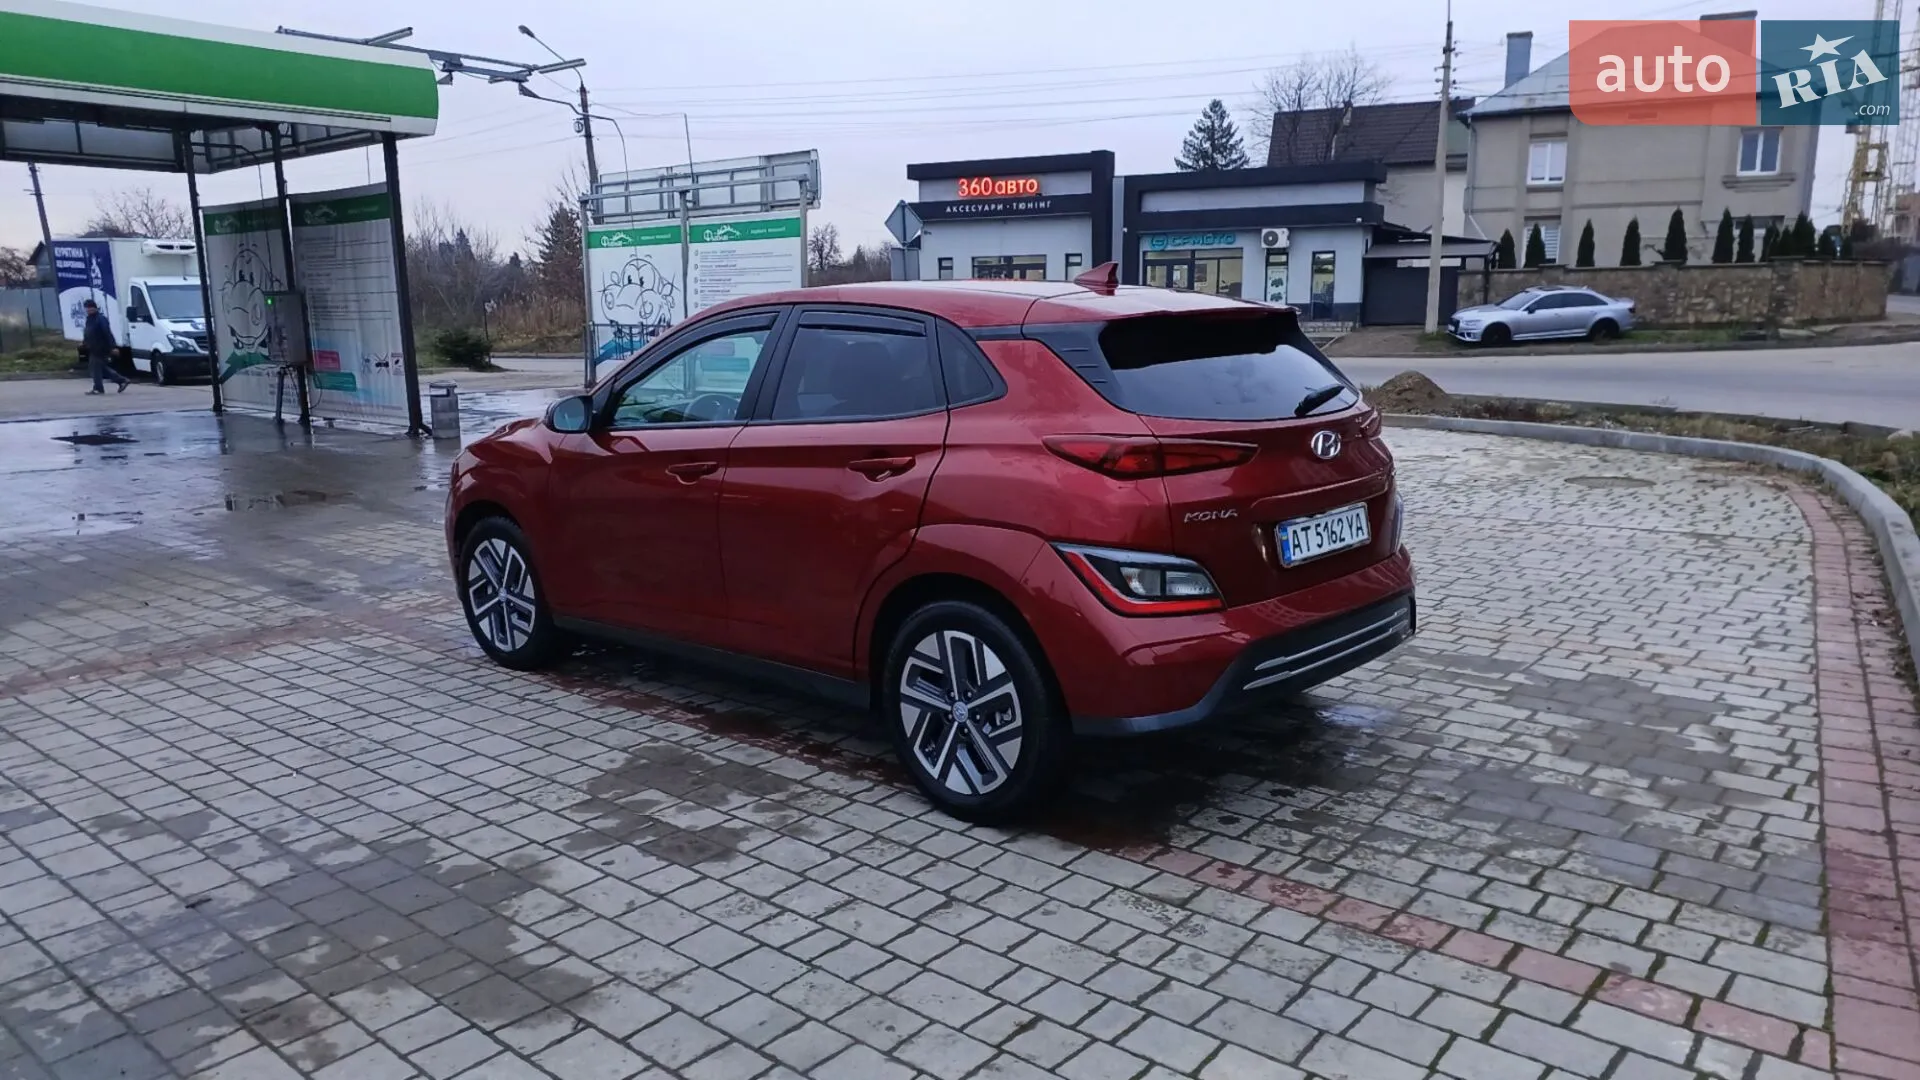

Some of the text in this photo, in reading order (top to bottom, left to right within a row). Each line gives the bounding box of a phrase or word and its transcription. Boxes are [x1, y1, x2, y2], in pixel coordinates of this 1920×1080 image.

[958, 177, 993, 197] 360
[945, 200, 1052, 213] АКСЕСУАРИ ТЮНІНГ
[1184, 509, 1238, 522] KONA
